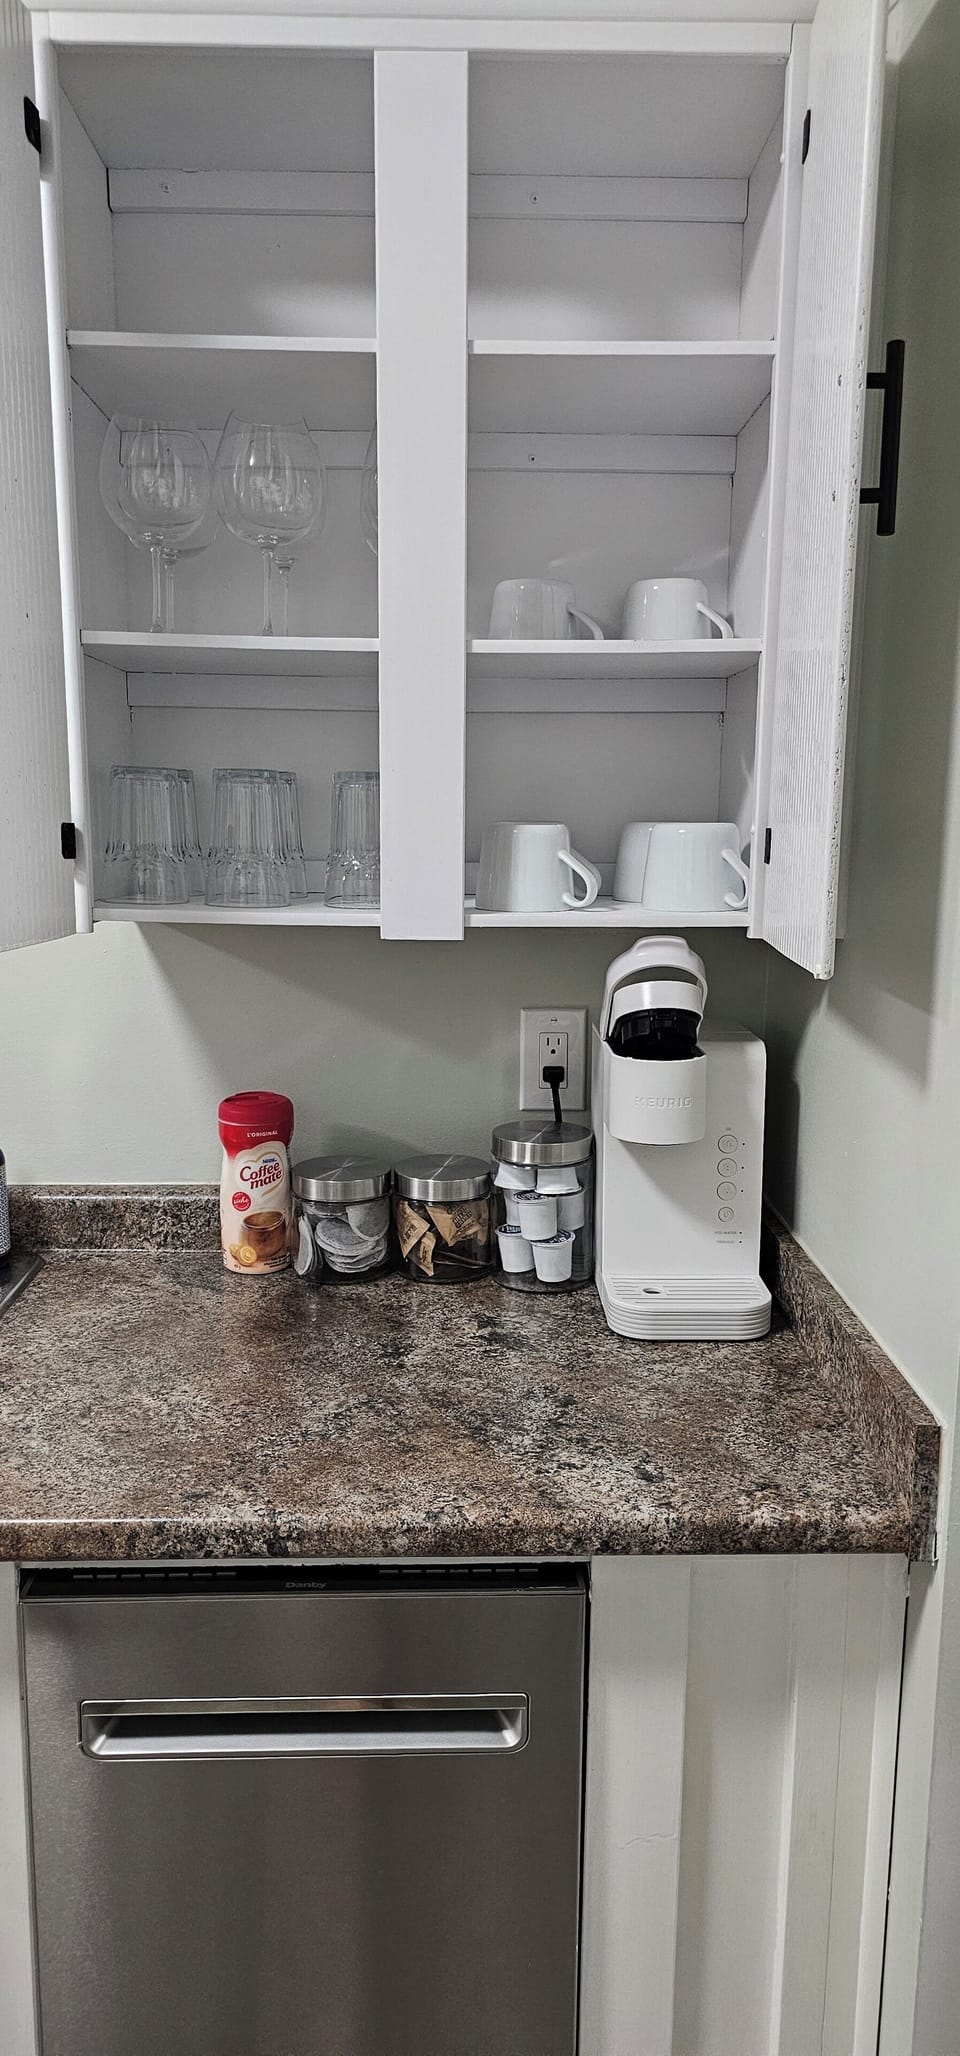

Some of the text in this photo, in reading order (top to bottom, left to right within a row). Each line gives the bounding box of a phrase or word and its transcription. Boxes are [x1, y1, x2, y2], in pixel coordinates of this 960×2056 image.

[633, 1096, 692, 1109] KEURIG
[246, 1130, 278, 1138] L'ORIGINAL
[239, 1162, 280, 1182] Coffee
[250, 1169, 282, 1190] mate
